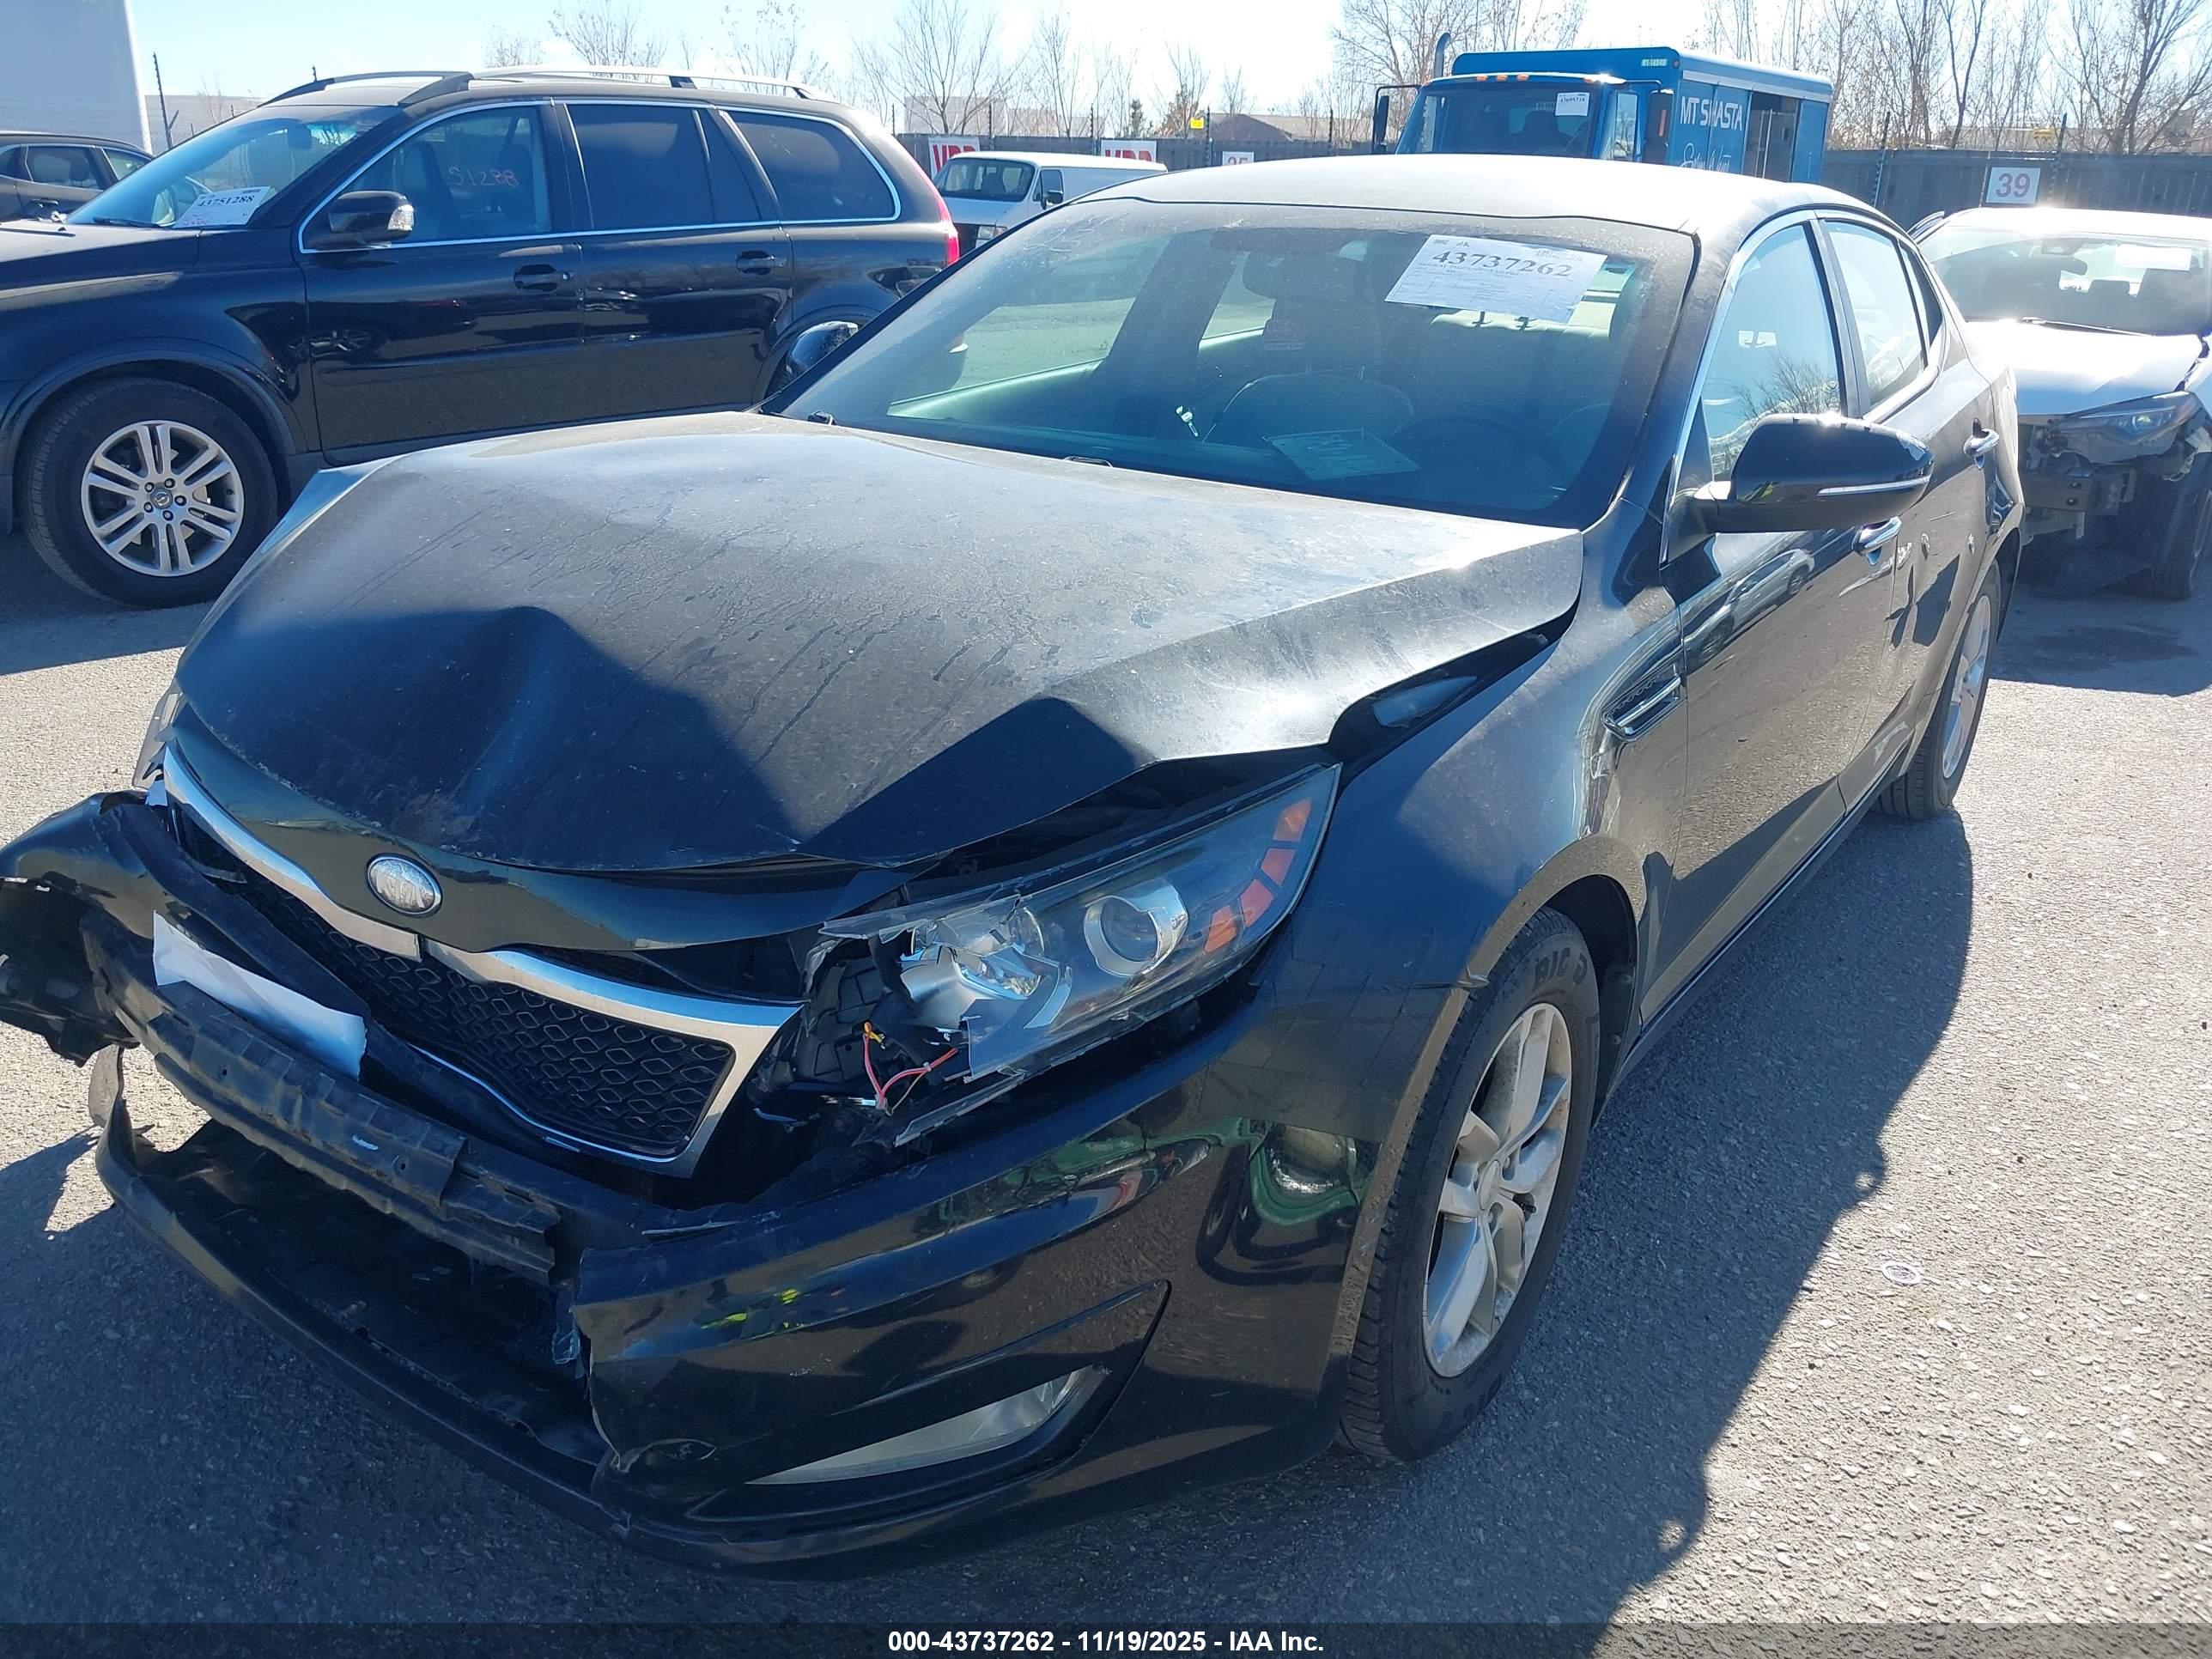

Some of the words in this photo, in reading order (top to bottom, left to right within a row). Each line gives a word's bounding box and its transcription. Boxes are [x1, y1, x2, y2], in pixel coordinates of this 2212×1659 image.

[1680, 96, 1700, 125] MT
[1996, 173, 2031, 198] 39
[1432, 250, 1573, 277] 43737262
